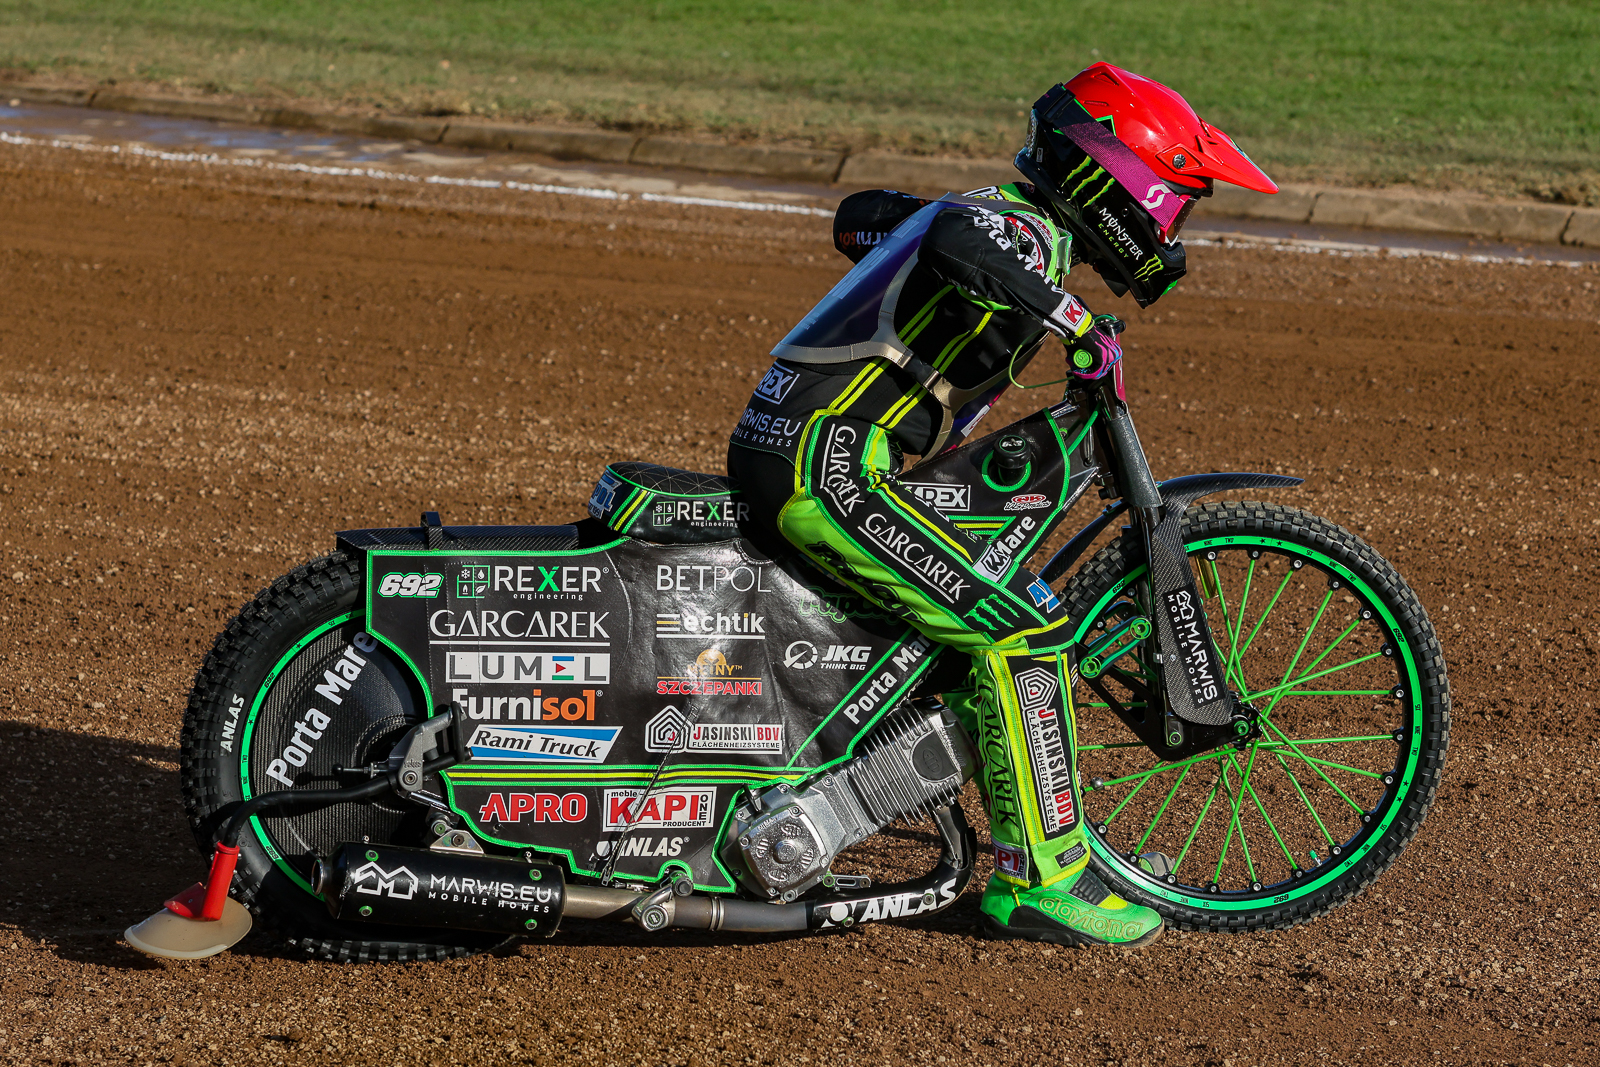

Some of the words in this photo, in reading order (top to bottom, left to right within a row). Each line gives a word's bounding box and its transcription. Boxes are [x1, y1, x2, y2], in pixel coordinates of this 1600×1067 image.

[677, 501, 750, 522] REXER
[864, 513, 971, 601] GARCAREK
[377, 571, 444, 598] 692
[656, 564, 771, 593] BETPOL
[513, 593, 584, 601] engineering
[429, 609, 611, 639] GARCAREK
[821, 645, 872, 663] JKG
[1167, 594, 1189, 649] MOBILE
[1184, 656, 1204, 705] HOMES
[1188, 622, 1218, 701] MARWIS
[820, 662, 848, 670] THINK
[850, 662, 866, 671] BIG
[843, 671, 896, 725] Porta
[892, 633, 931, 672] Mar
[656, 681, 762, 696] SZCZEPANKI
[220, 693, 245, 752] ANLAS
[265, 707, 331, 788] Porta
[314, 631, 378, 706] Mare
[473, 730, 534, 753] Rami
[538, 736, 602, 758] Truck
[692, 725, 751, 741] JASINSKI
[757, 726, 780, 742] BDV
[1037, 708, 1070, 791] JASINSKI
[1055, 790, 1076, 831] BDV
[479, 792, 588, 823] APRO
[609, 794, 699, 824] KAPI
[661, 820, 707, 828] PRODUCENT
[428, 891, 488, 906] MOBILE
[497, 900, 550, 913] HOMES
[430, 873, 552, 903] MARWIS.EU
[859, 878, 957, 923] ANLAS
